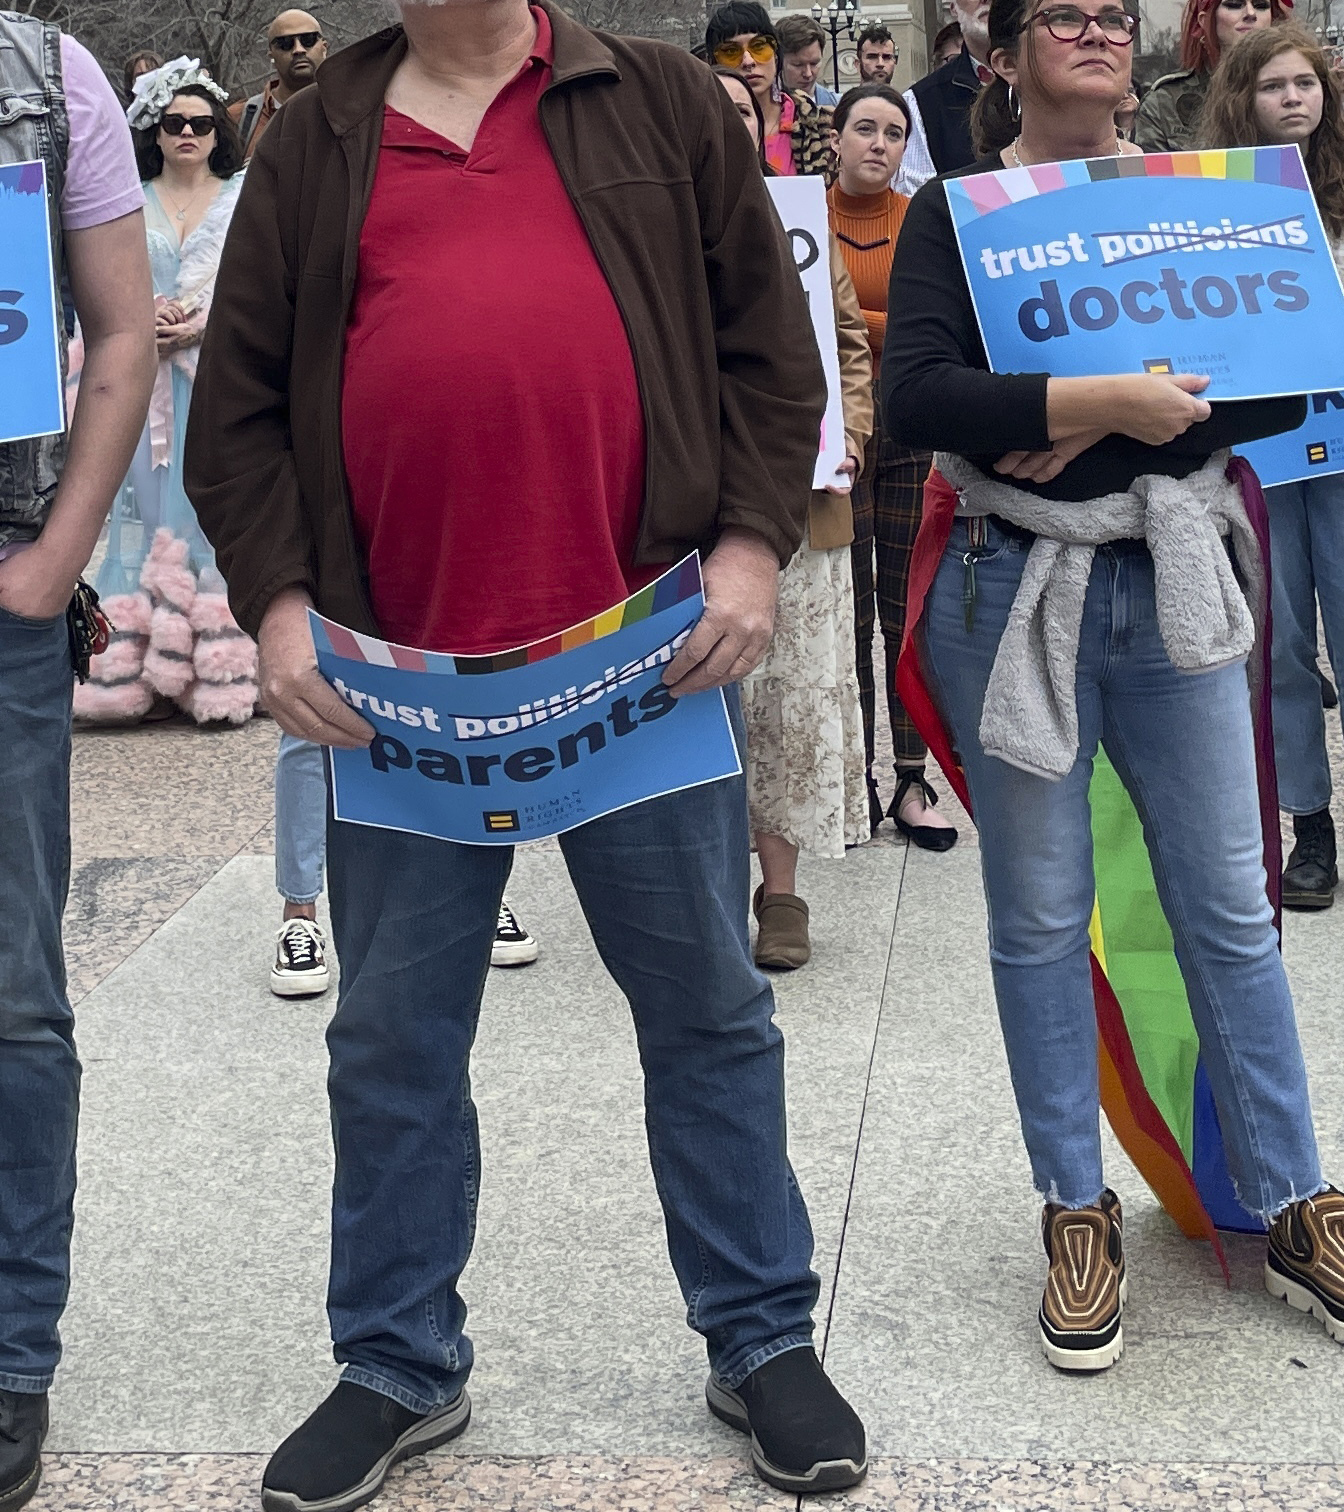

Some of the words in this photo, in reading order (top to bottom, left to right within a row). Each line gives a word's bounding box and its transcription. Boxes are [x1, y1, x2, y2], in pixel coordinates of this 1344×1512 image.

[980, 233, 1090, 279] trust
[1098, 213, 1310, 265] politicians
[1017, 267, 1310, 343] doctors
[333, 676, 442, 734] trust
[454, 627, 693, 741] politicians
[369, 682, 681, 787] parents
